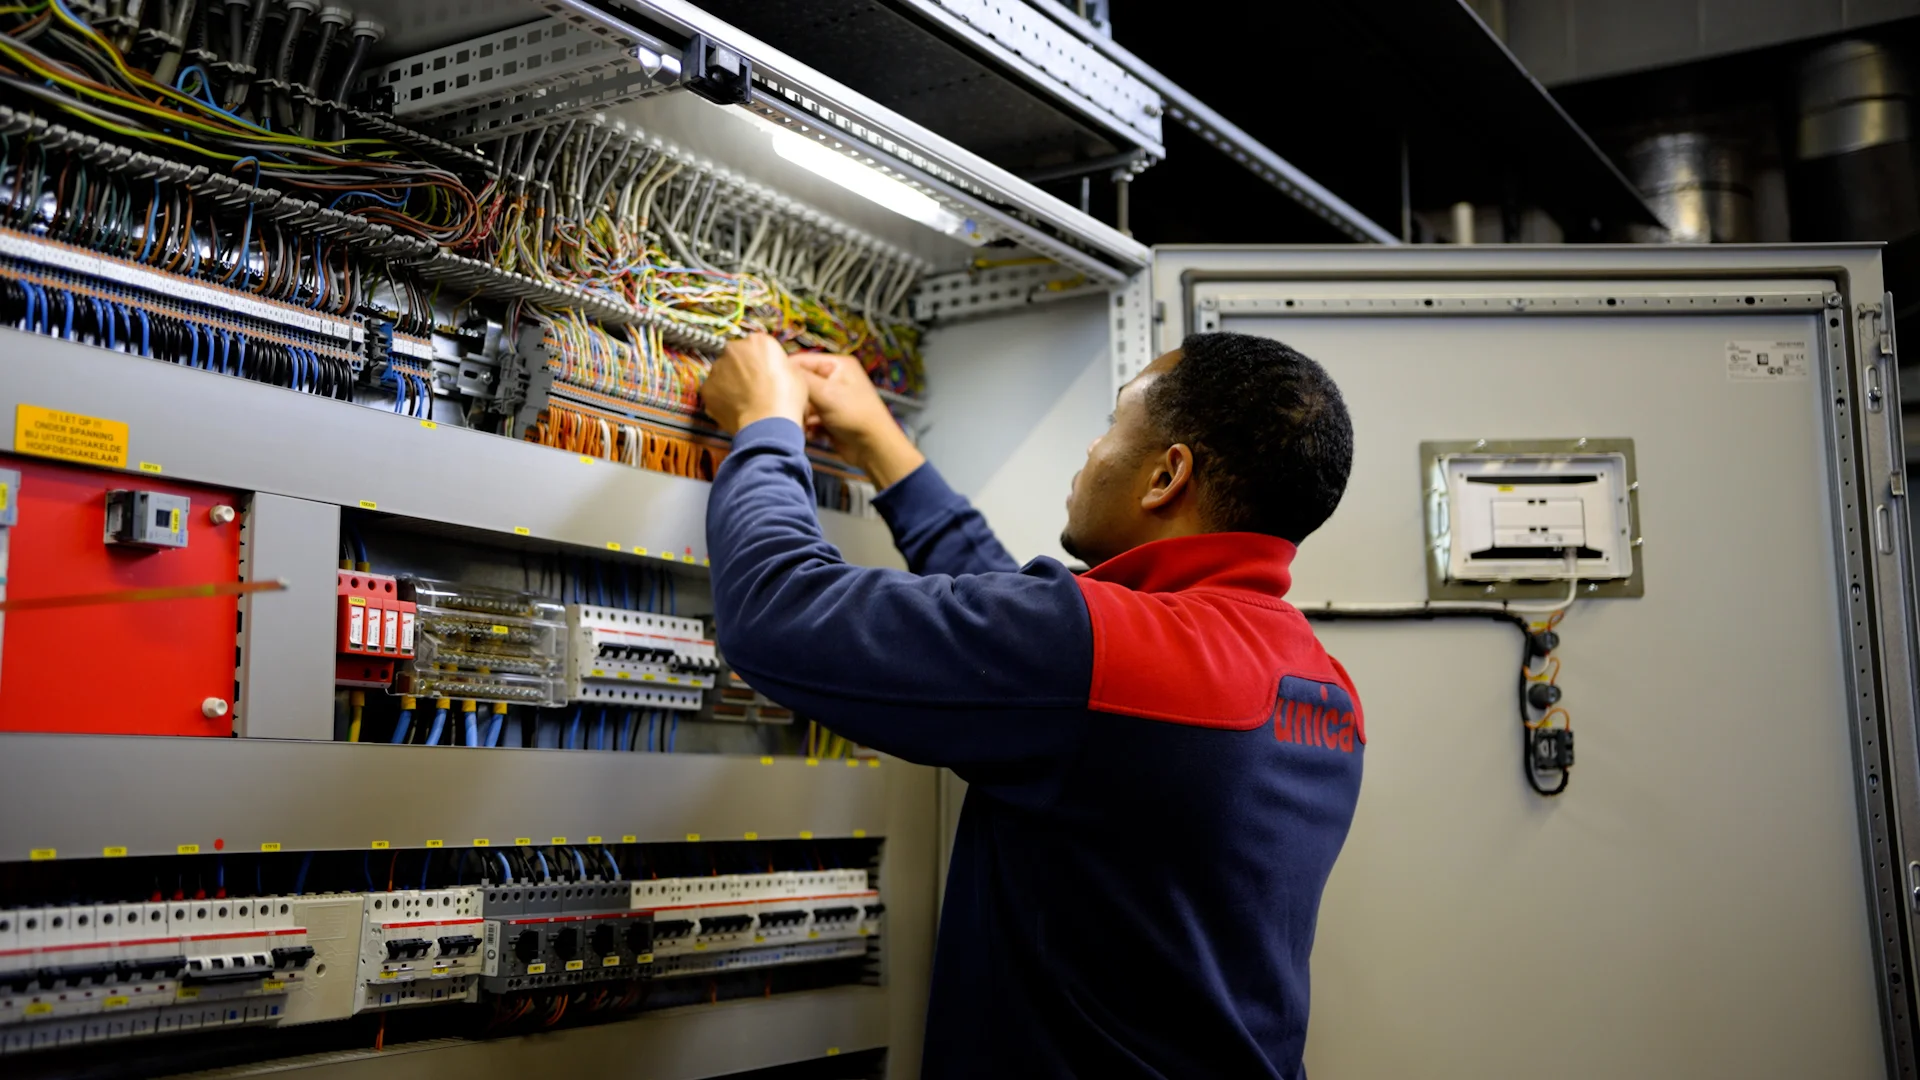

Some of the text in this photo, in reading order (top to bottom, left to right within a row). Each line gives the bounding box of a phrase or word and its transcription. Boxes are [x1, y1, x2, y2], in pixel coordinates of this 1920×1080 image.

[34, 420, 114, 441] ONDER SPANNING
[59, 413, 76, 424] LET
[79, 416, 91, 426] OP
[24, 429, 122, 454] BIJ UITGESCHAKELDE
[25, 441, 119, 464] HOOFDSCHAKELAAR
[1274, 684, 1355, 753] unica
